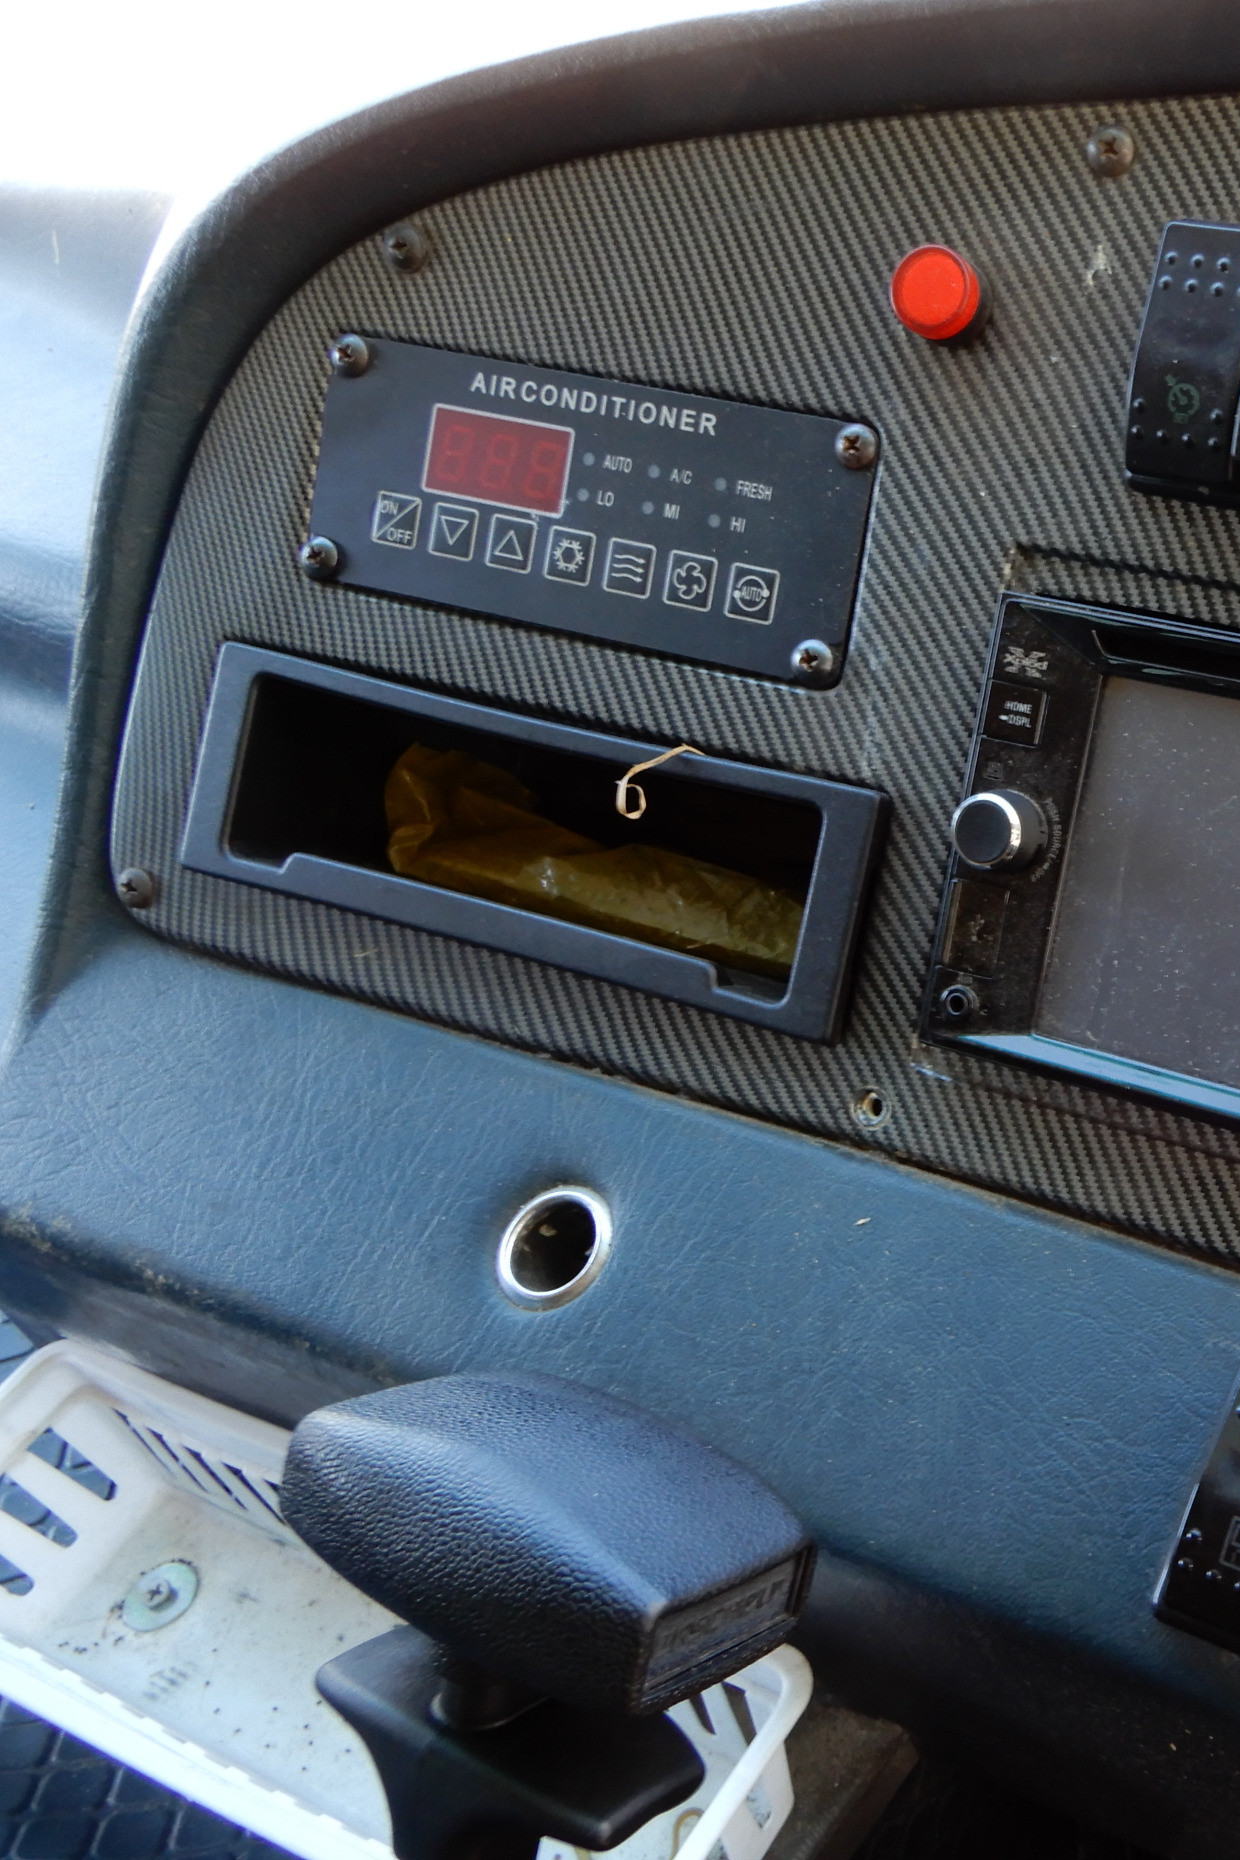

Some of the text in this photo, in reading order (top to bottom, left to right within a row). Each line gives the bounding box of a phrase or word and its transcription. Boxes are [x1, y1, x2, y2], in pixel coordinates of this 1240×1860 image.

[470, 372, 717, 436] AIRCONDITIONER
[603, 454, 633, 474] AUTO
[670, 468, 693, 486] A/C
[597, 489, 615, 507] LO
[735, 479, 773, 501] FRESH
[380, 500, 400, 516] ON
[663, 503, 681, 521] MI
[730, 516, 747, 534] HI
[388, 527, 413, 545] OFF
[741, 586, 763, 602] AUTO
